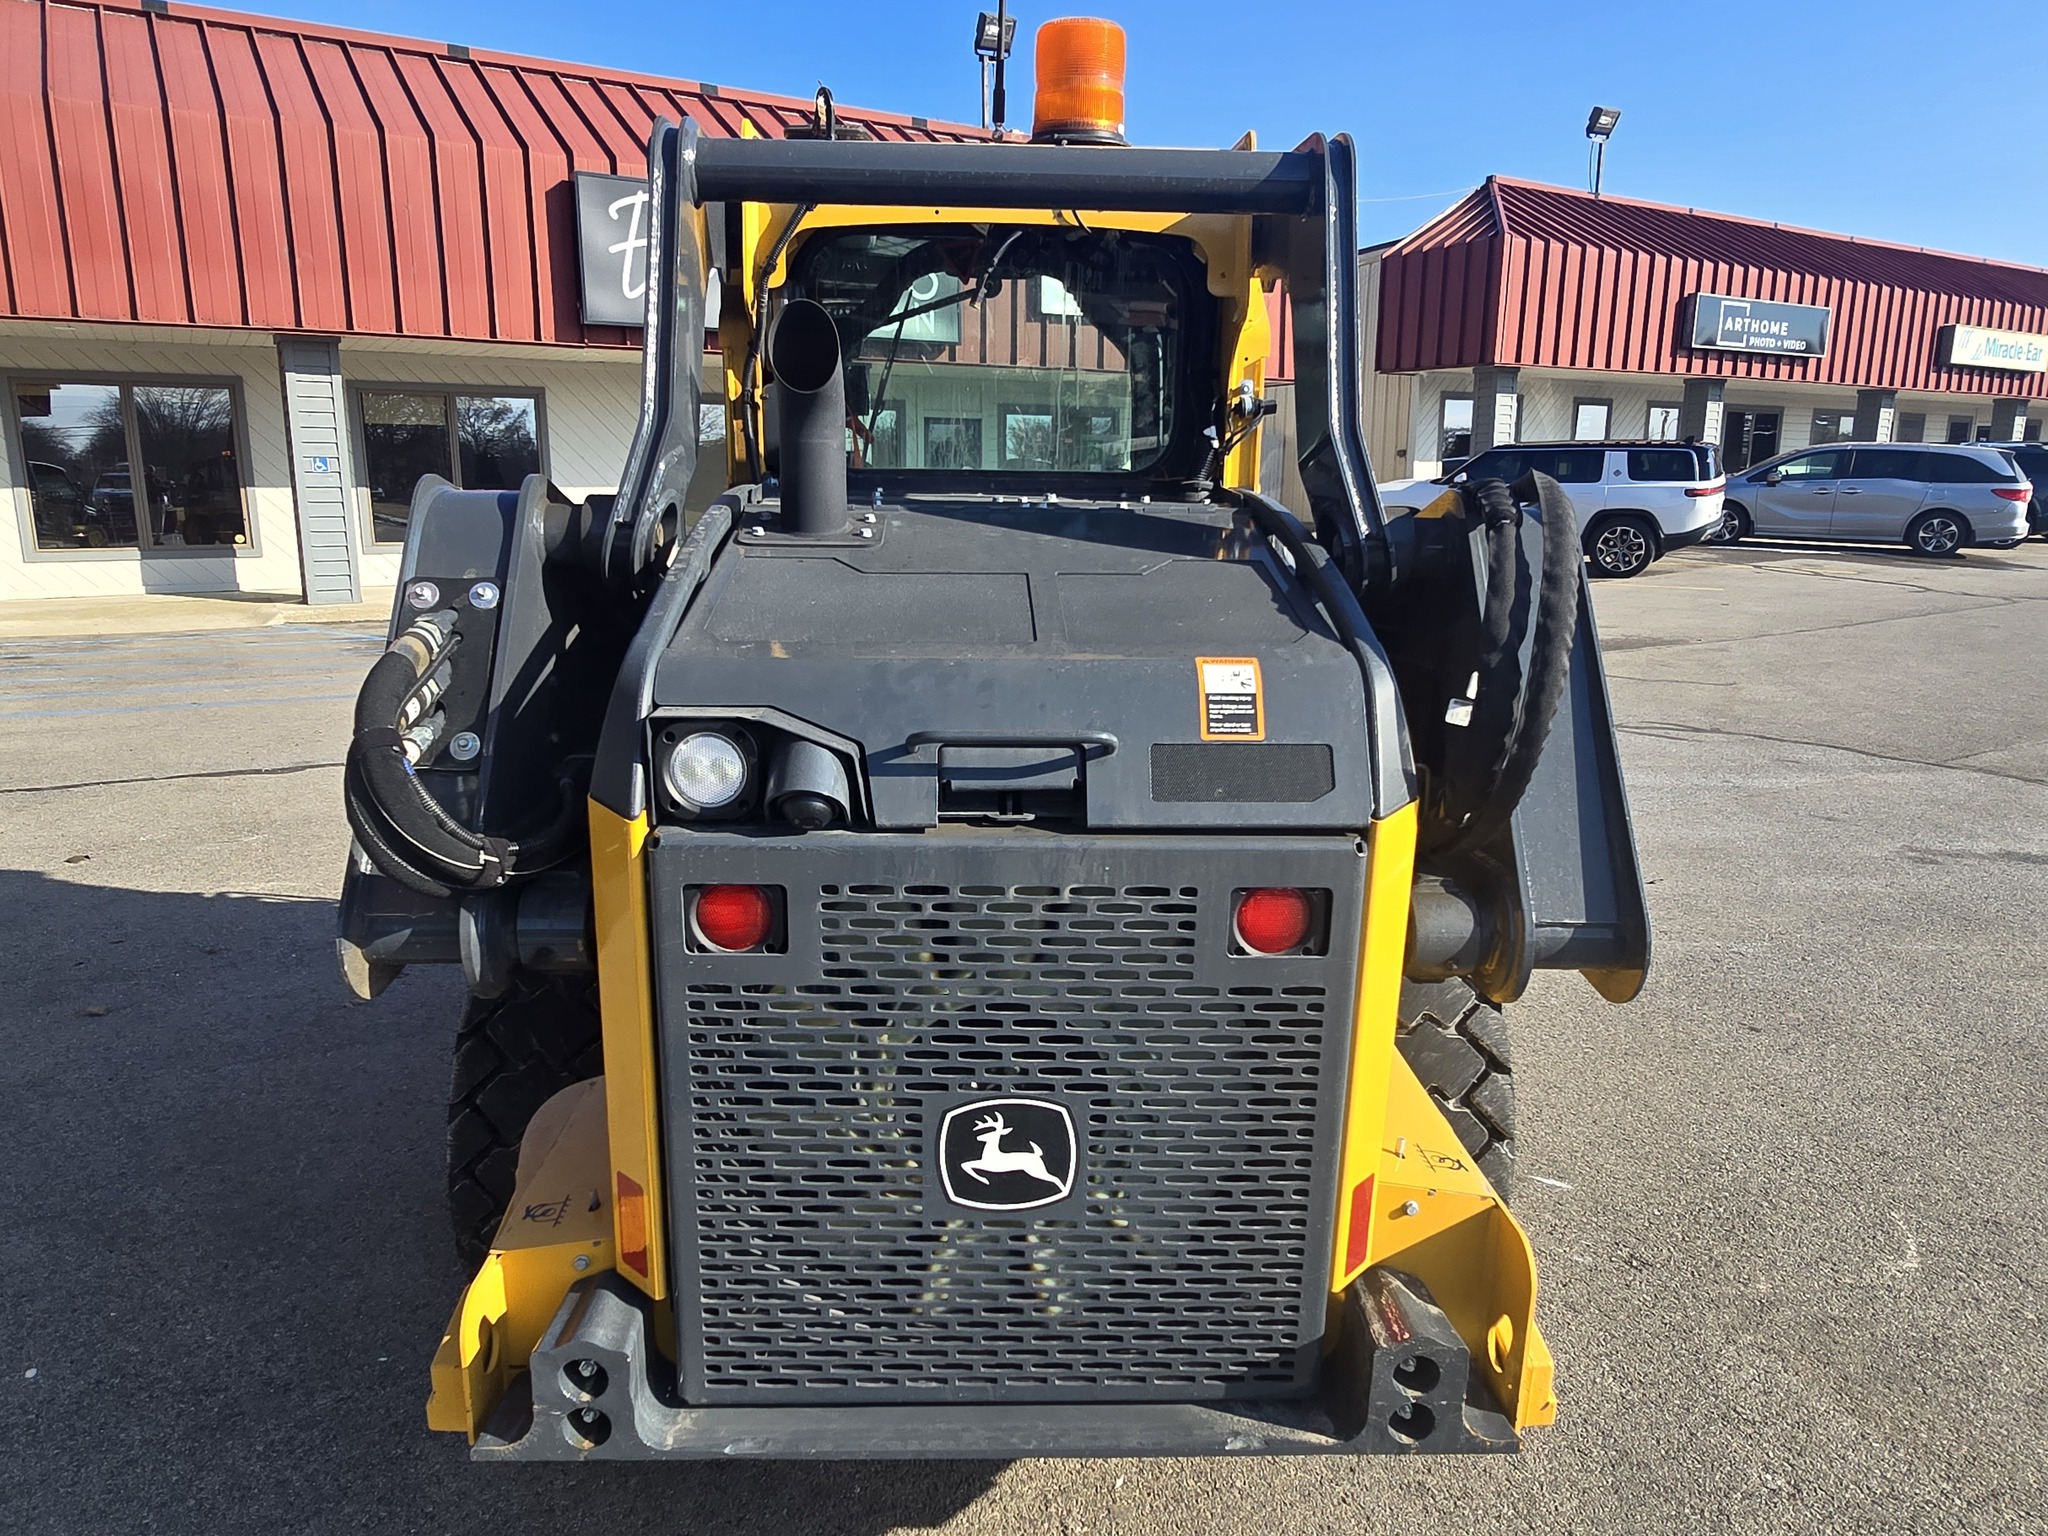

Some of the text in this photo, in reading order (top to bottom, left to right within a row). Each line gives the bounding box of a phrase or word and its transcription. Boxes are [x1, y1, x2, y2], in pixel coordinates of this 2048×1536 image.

[1724, 316, 1789, 336] ARTHOME
[1748, 336, 1776, 348] PHOTO
[1783, 339, 1807, 350] VIDEO
